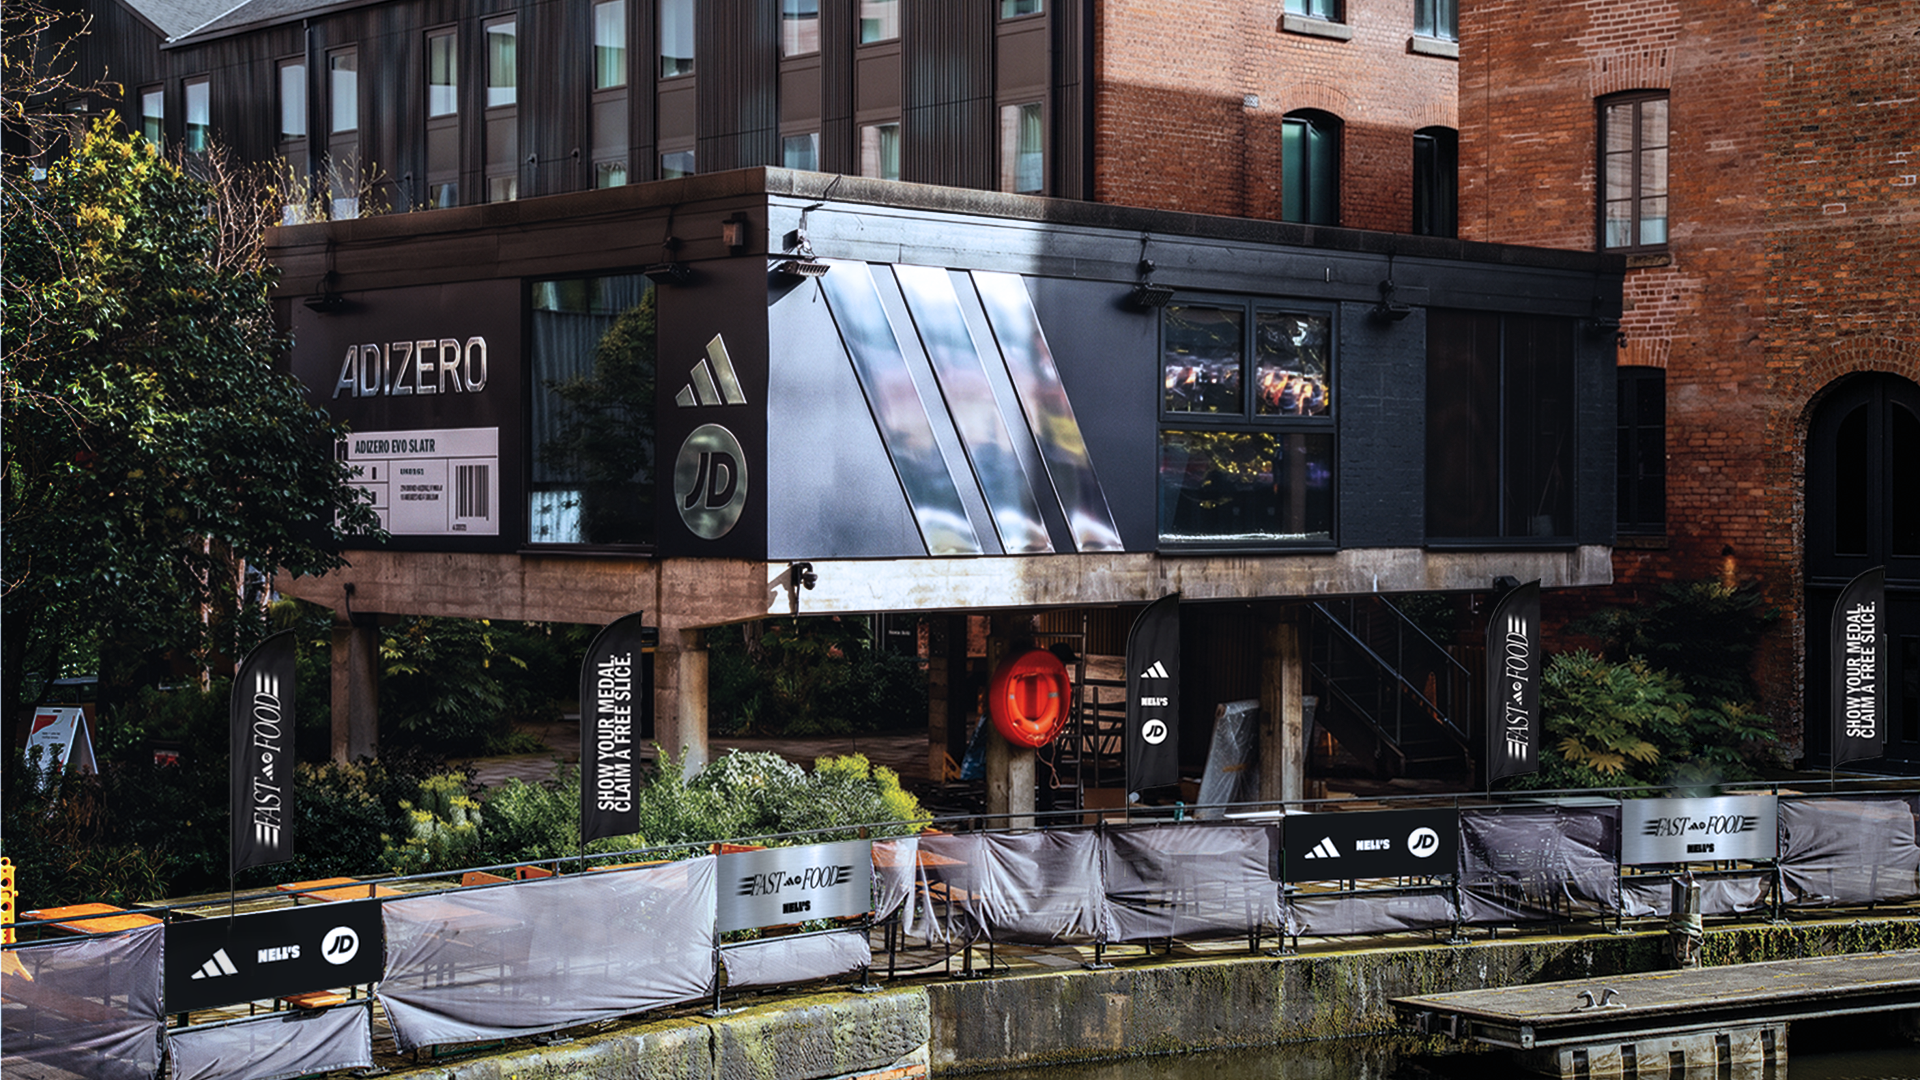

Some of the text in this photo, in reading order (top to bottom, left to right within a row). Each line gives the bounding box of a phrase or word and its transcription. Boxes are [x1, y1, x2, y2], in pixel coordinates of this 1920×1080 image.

[332, 336, 488, 399] ADIZERO
[354, 440, 390, 454] ADIZERO
[391, 439, 407, 453] EVO
[408, 438, 435, 453] SLATR
[684, 451, 739, 510] JD
[1505, 632, 1529, 682] FOOD
[1846, 603, 1861, 738] SHOW YOUR MEDAL.
[1861, 601, 1876, 739] CLAIM A FREE SLICE.
[253, 692, 281, 752] FOOD
[1141, 697, 1169, 707] NELL'S
[1505, 701, 1529, 747] FAST
[598, 654, 615, 812] SHOW YOUR MEDAL.
[614, 652, 632, 812] CLAIM A FREE SLICE.
[1146, 725, 1164, 738] JD
[253, 776, 281, 831] FAST
[1654, 815, 1746, 837] FAST FOOD
[1356, 834, 1435, 851] NELL'S JD
[750, 865, 841, 897] FAST FOOD
[782, 900, 811, 914] NELL'S
[257, 934, 354, 964] NELL'S JD
